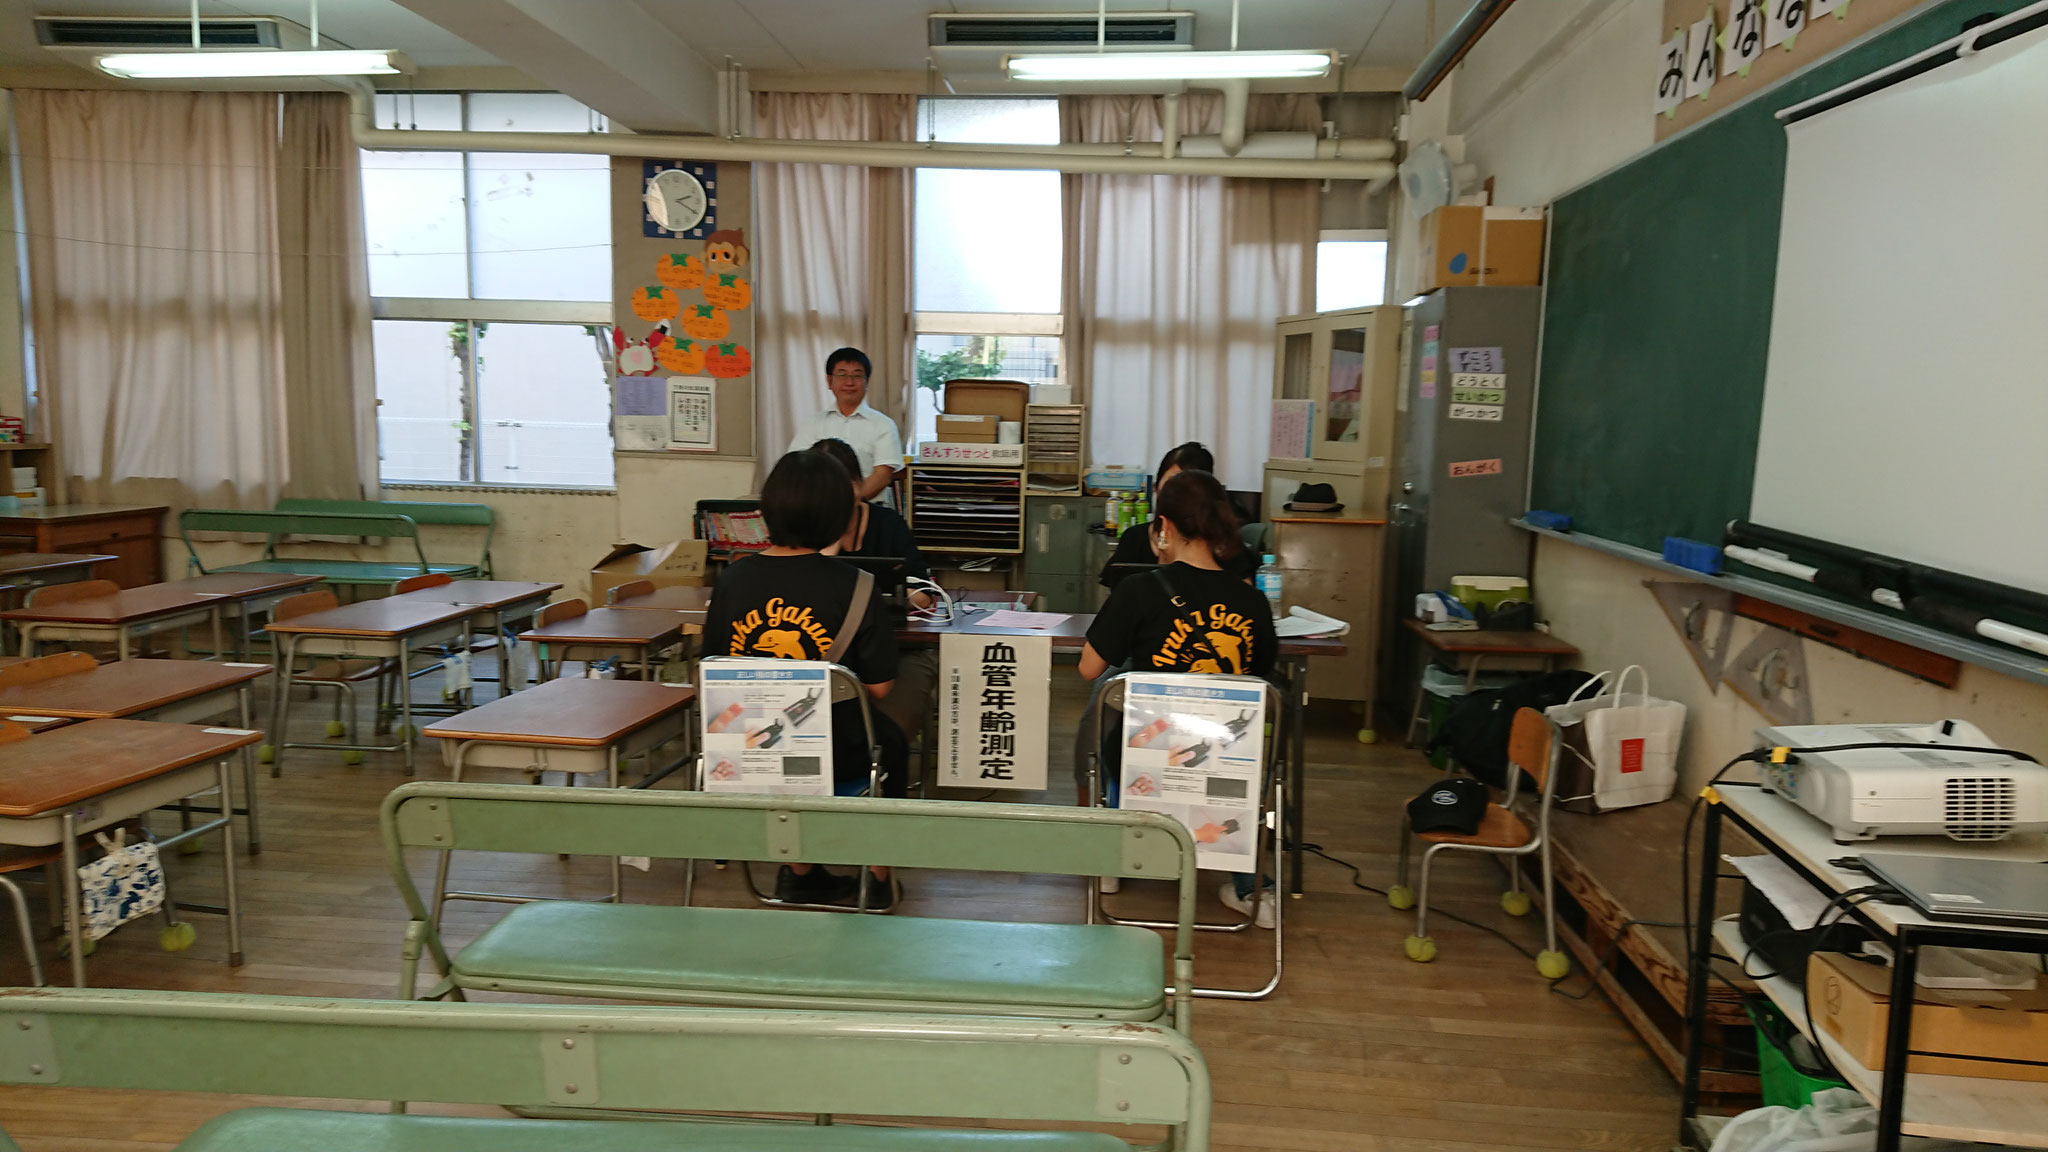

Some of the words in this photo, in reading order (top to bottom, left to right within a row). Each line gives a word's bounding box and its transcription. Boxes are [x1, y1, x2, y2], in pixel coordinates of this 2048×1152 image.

[1659, 0, 1827, 98] みんな
[1456, 376, 1501, 387] どうとく
[1455, 392, 1501, 402] せいかつ
[922, 446, 990, 459] さんすうせっと
[1453, 462, 1496, 475] おんがく
[979, 642, 1017, 780] 血管年齢測定
